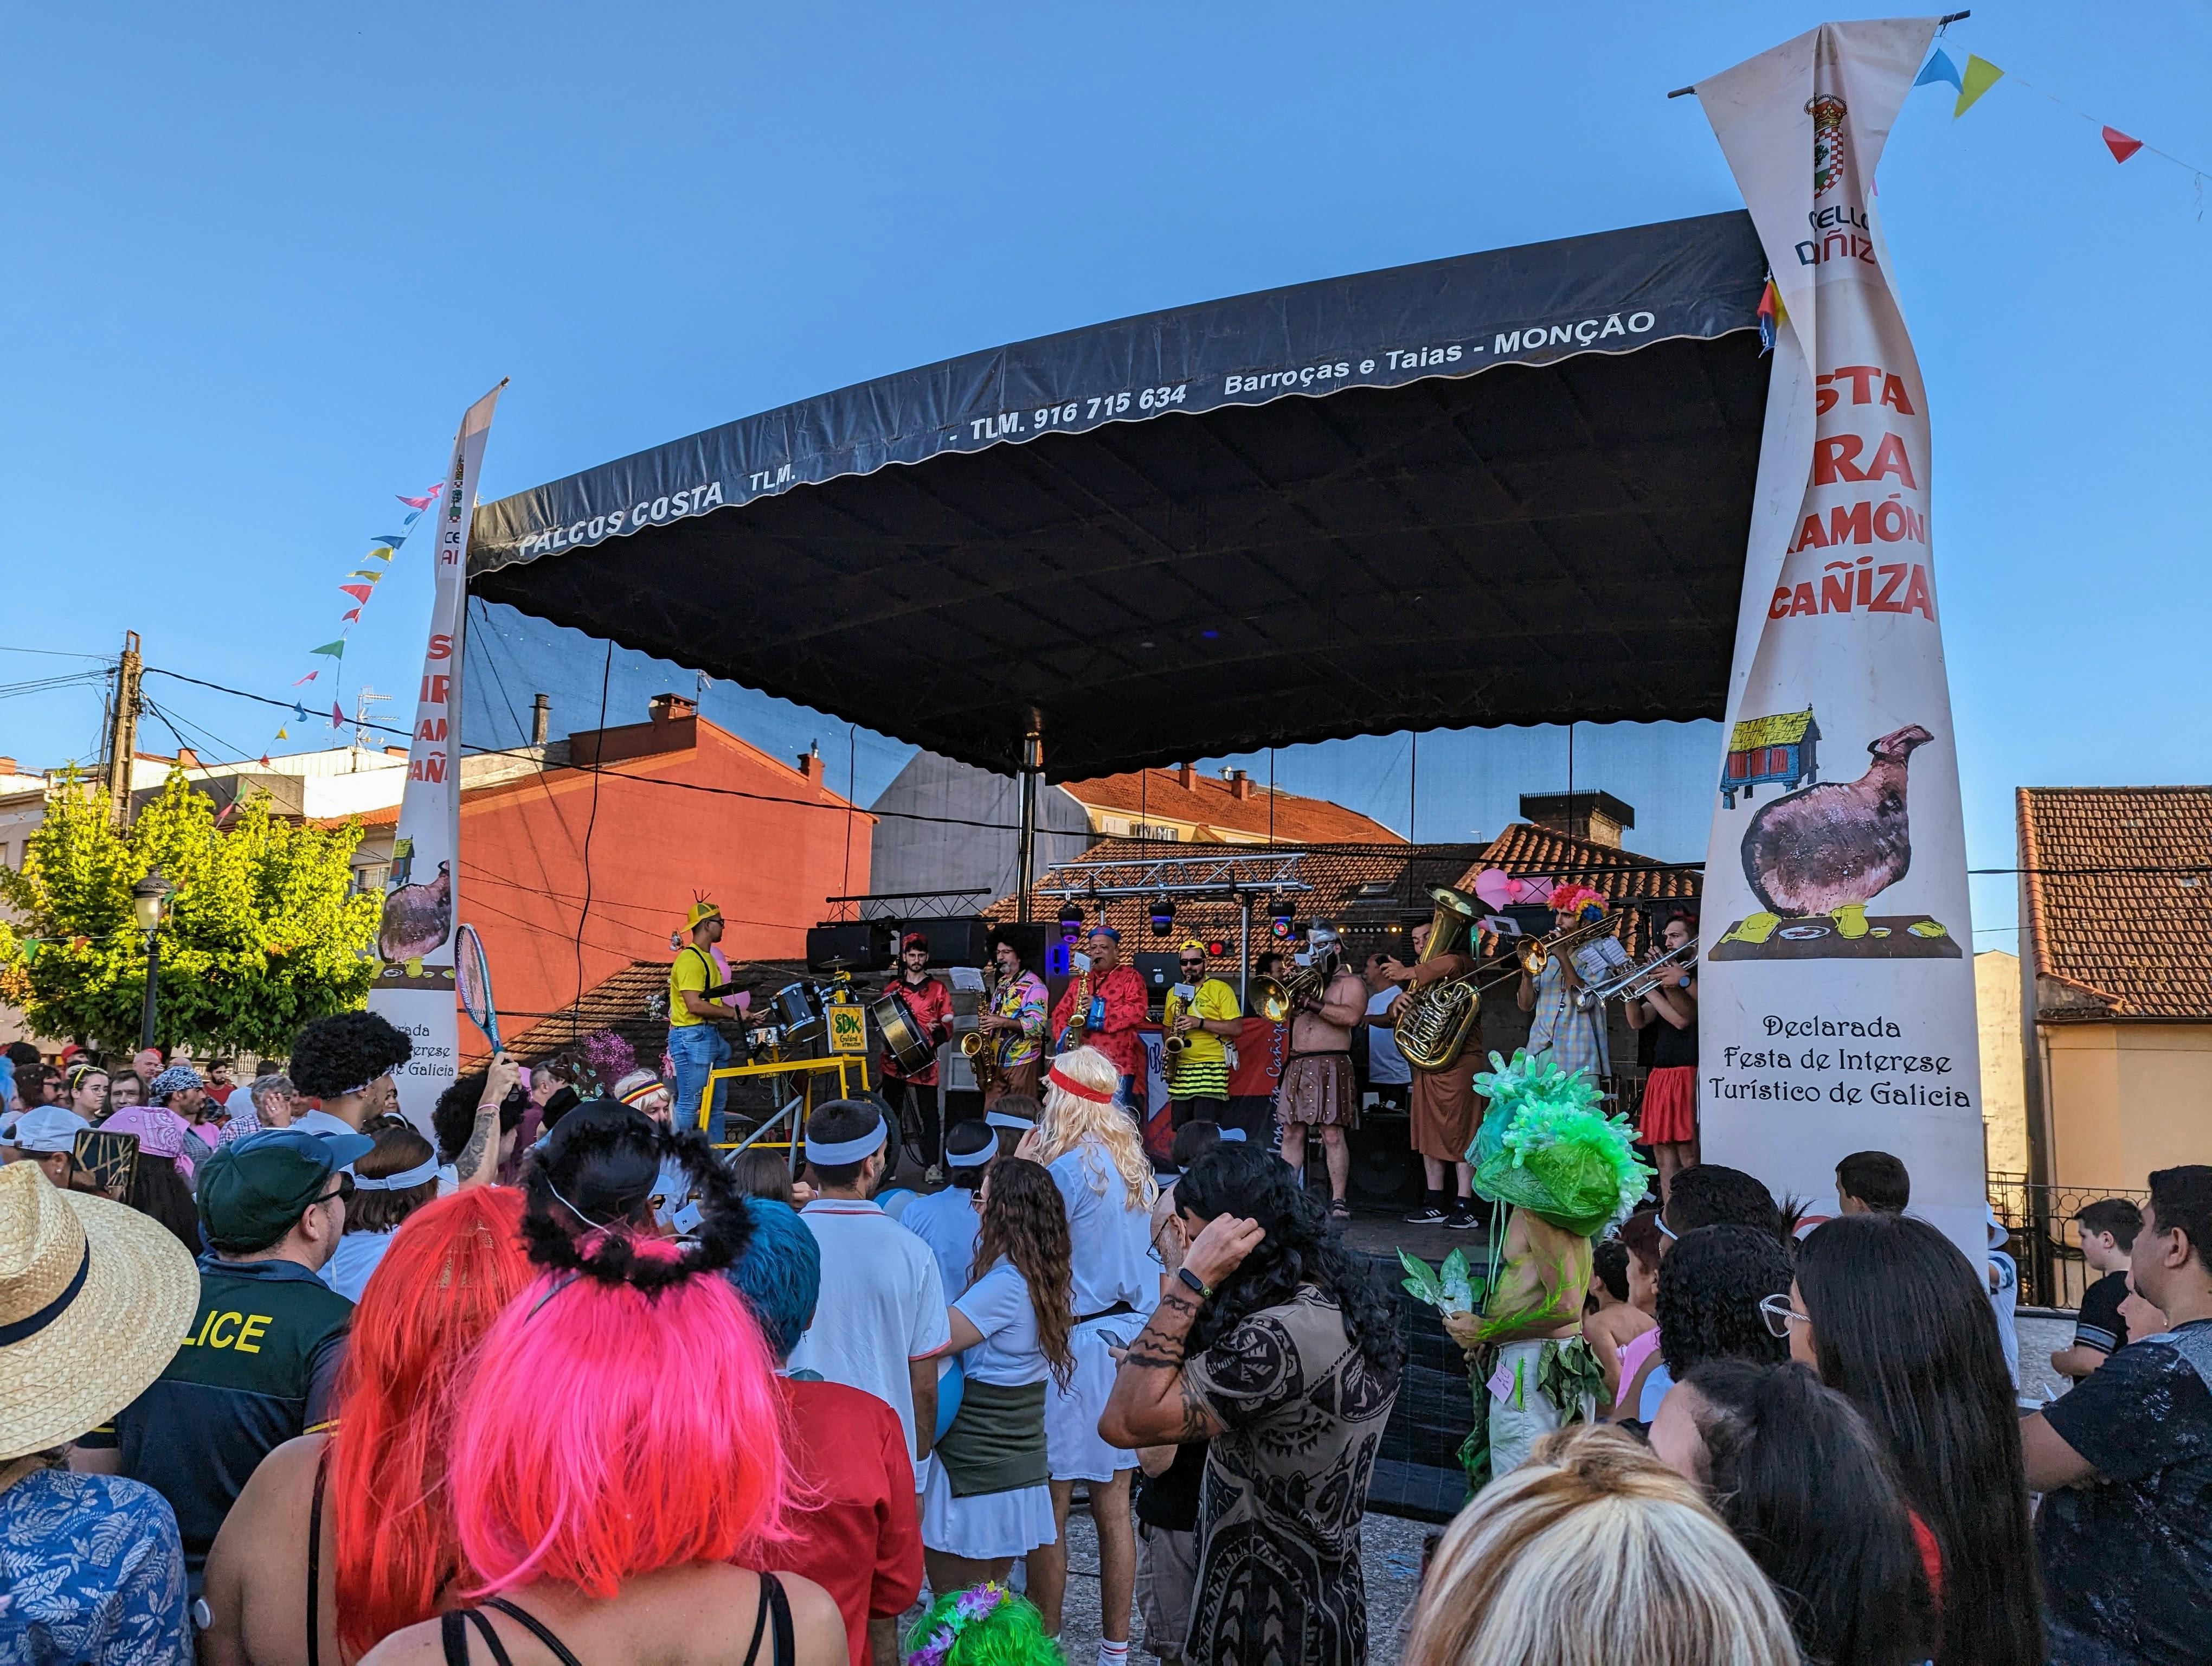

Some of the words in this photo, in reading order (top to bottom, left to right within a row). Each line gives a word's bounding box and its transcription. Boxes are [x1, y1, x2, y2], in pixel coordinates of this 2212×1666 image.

[1816, 366, 1915, 416] STA
[518, 509, 624, 556] PALCOS
[631, 482, 724, 527] COSTA
[749, 463, 796, 492] TLM.
[970, 412, 1025, 440] TLM.
[1034, 403, 1078, 430] 916
[1086, 392, 1131, 420] 715
[1139, 384, 1187, 409] 634
[1224, 361, 1349, 395] Barroças
[1360, 358, 1375, 374] e
[1386, 345, 1462, 370] Taias
[1494, 311, 1656, 355] MONÇÃO
[1814, 432, 1918, 490] RA
[1787, 493, 1925, 554] AMÓN
[1266, 1023, 1289, 1077] Cañiz
[1763, 1015, 1901, 1038] Declarada
[409, 1061, 454, 1077] Galicia
[1724, 1046, 1792, 1069] Festa
[1801, 1048, 1831, 1072] de
[1839, 1048, 1952, 1075] Interese
[1709, 1077, 1821, 1102] Turístico
[1829, 1081, 1863, 1106] de
[1870, 1081, 1971, 1108] Galicia
